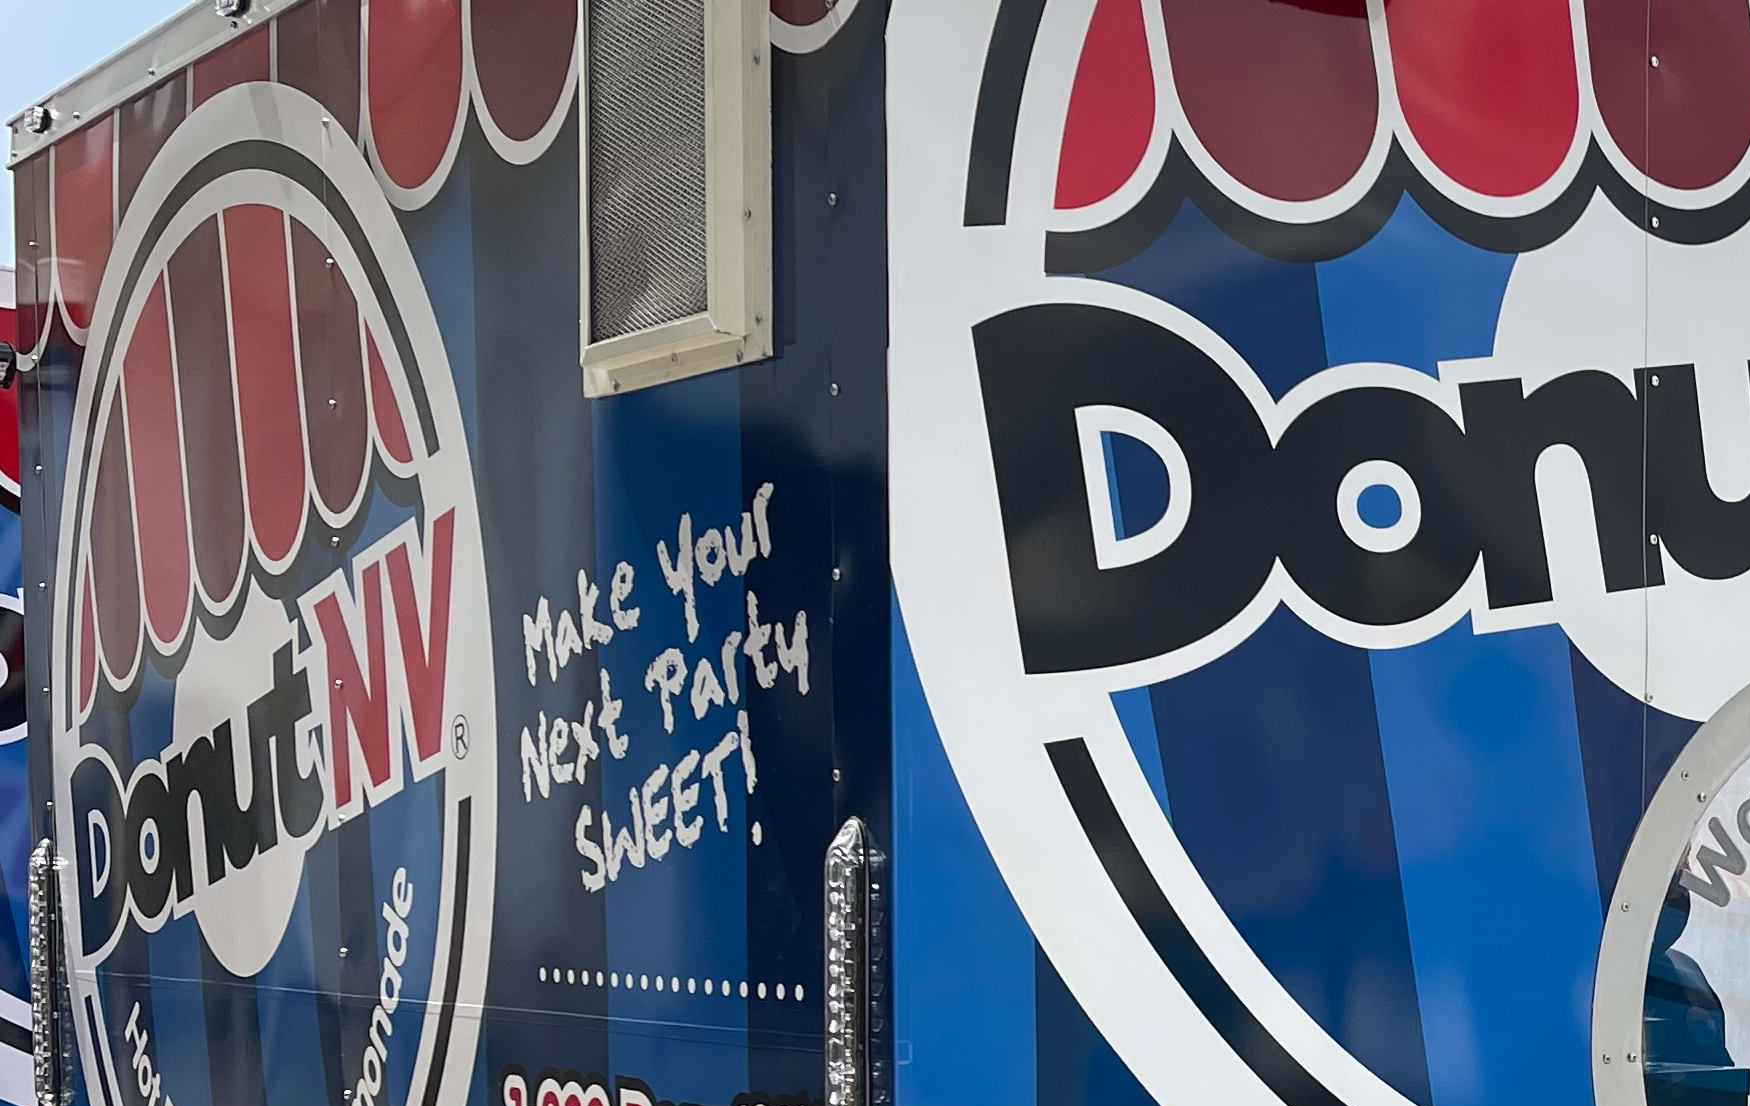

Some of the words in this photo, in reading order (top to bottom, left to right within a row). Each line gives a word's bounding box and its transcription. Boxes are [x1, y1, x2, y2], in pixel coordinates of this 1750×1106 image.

[522, 669, 628, 801] Next
[647, 591, 809, 734] Party
[524, 560, 640, 685] Make
[72, 506, 457, 958] DonutNV
[577, 715, 763, 891] SWEET!
